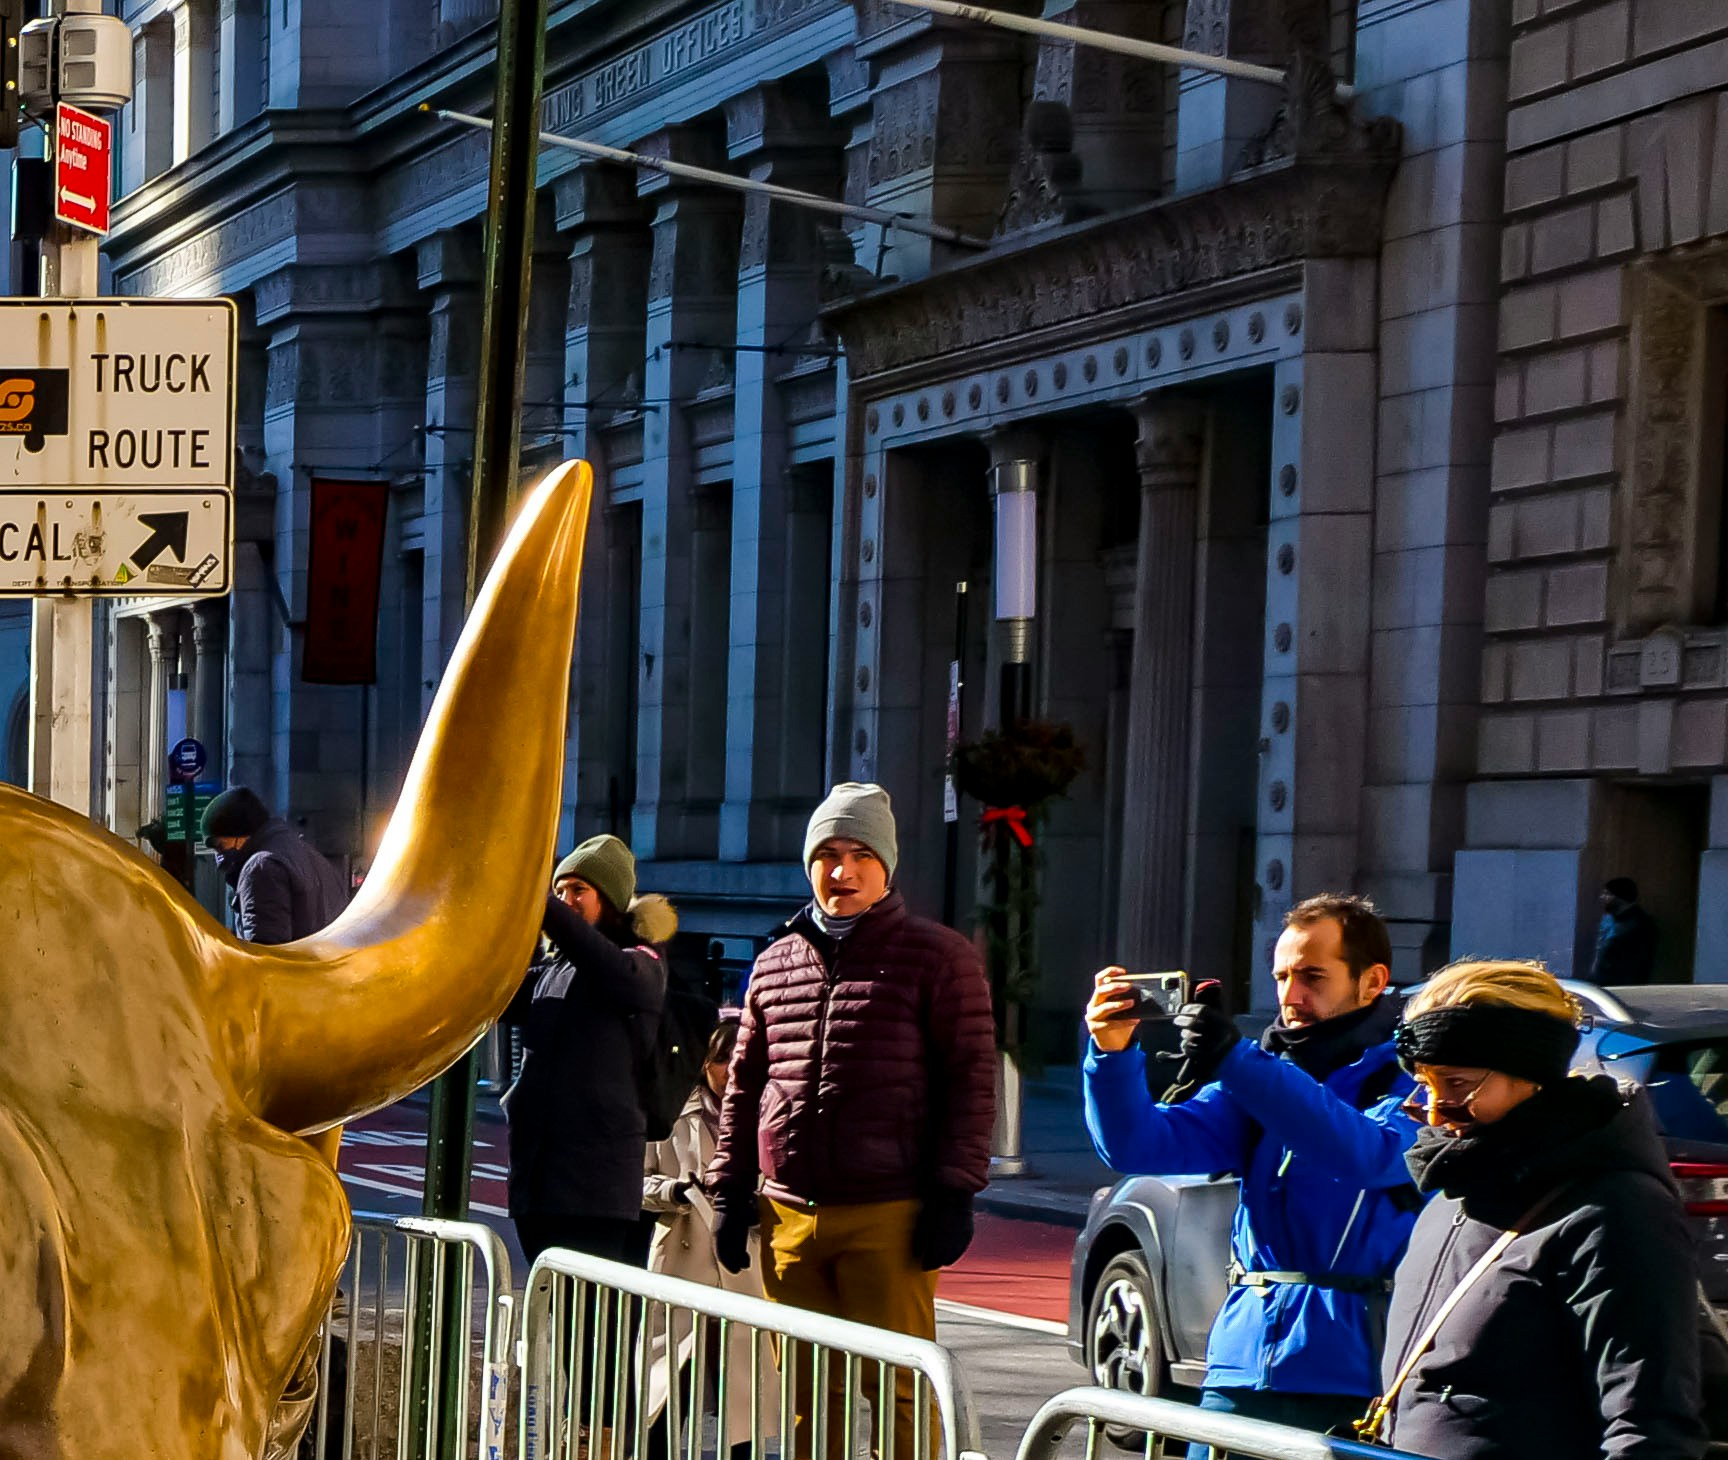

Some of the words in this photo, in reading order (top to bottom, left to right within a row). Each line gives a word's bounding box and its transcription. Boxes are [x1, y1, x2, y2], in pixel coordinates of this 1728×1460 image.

[60, 115, 71, 138] NO
[71, 120, 103, 151] STANDING
[60, 143, 88, 171] Anytime
[90, 353, 212, 393] TRUCK
[88, 429, 210, 469] ROUTE
